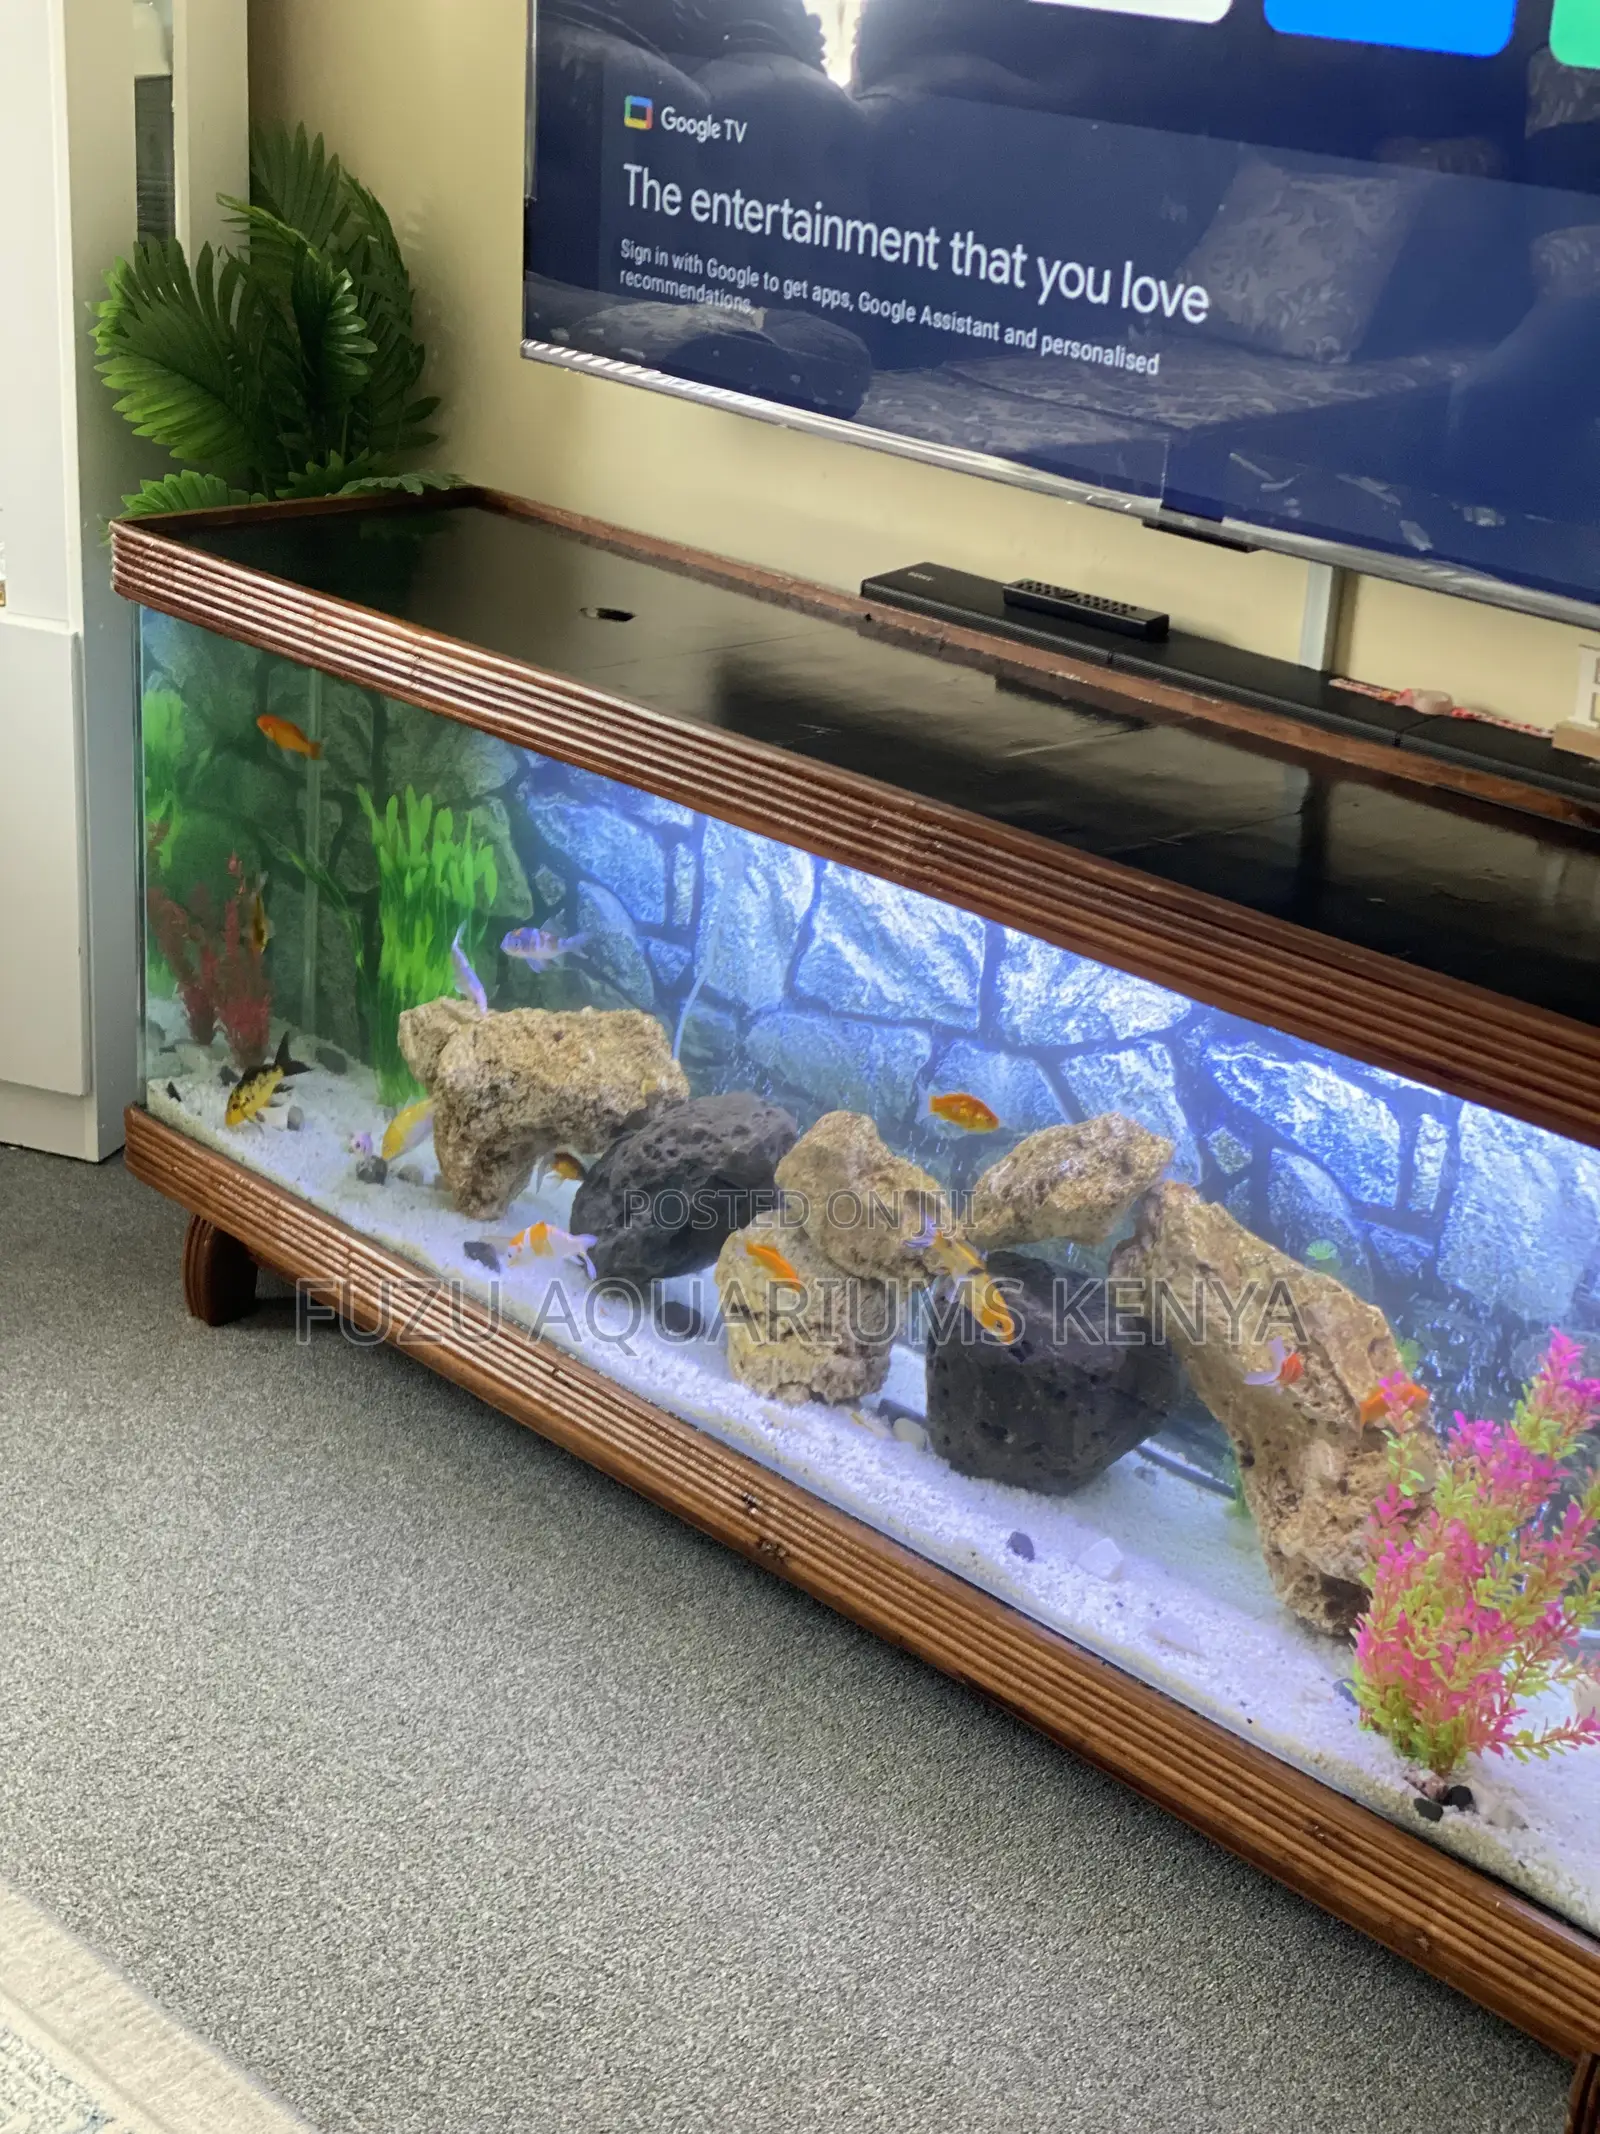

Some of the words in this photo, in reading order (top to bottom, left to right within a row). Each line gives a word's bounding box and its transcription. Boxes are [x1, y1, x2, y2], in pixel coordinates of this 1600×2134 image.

[660, 106, 721, 143] Google
[724, 119, 747, 143] TV
[620, 238, 651, 266] Sign
[655, 245, 668, 267] in
[671, 251, 703, 274] with
[706, 258, 759, 289] Google
[763, 271, 779, 291] to
[783, 278, 808, 300] get
[812, 285, 854, 311] apps,
[858, 291, 916, 324] Google
[919, 305, 1000, 342] Assistant
[1004, 327, 1037, 350] and
[1041, 334, 1160, 376] personalised
[623, 163, 682, 216] The
[690, 189, 941, 271] entertainment
[949, 231, 1028, 288] that
[1037, 256, 1112, 305] you
[1121, 260, 1209, 323] love
